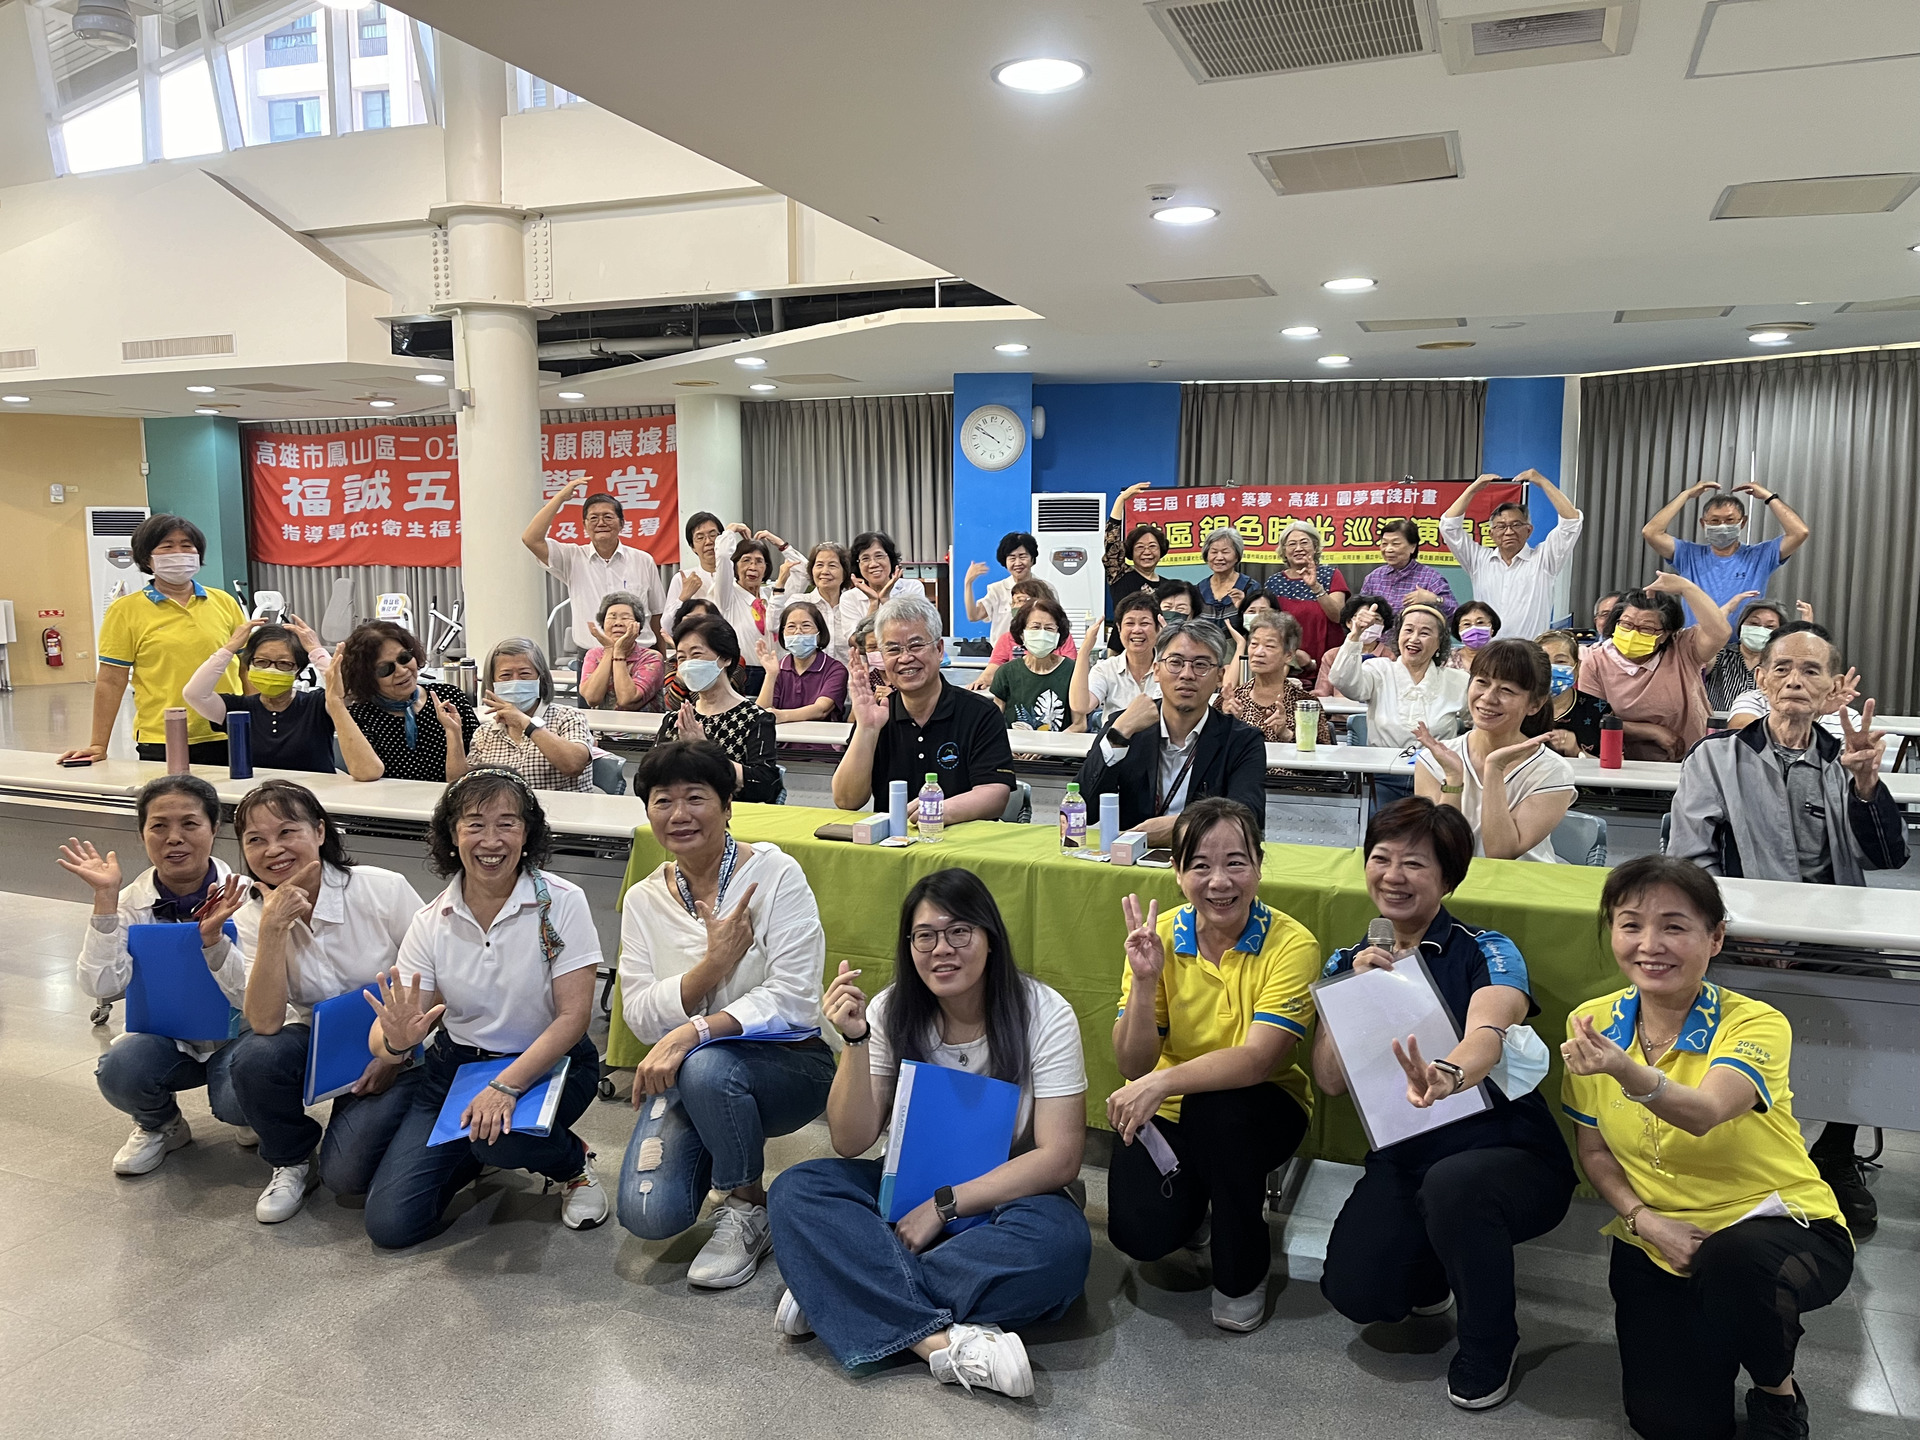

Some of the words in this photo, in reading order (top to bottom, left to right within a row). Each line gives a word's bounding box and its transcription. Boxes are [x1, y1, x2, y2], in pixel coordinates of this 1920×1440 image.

[281, 519, 462, 544] 指導單位:衛生福
